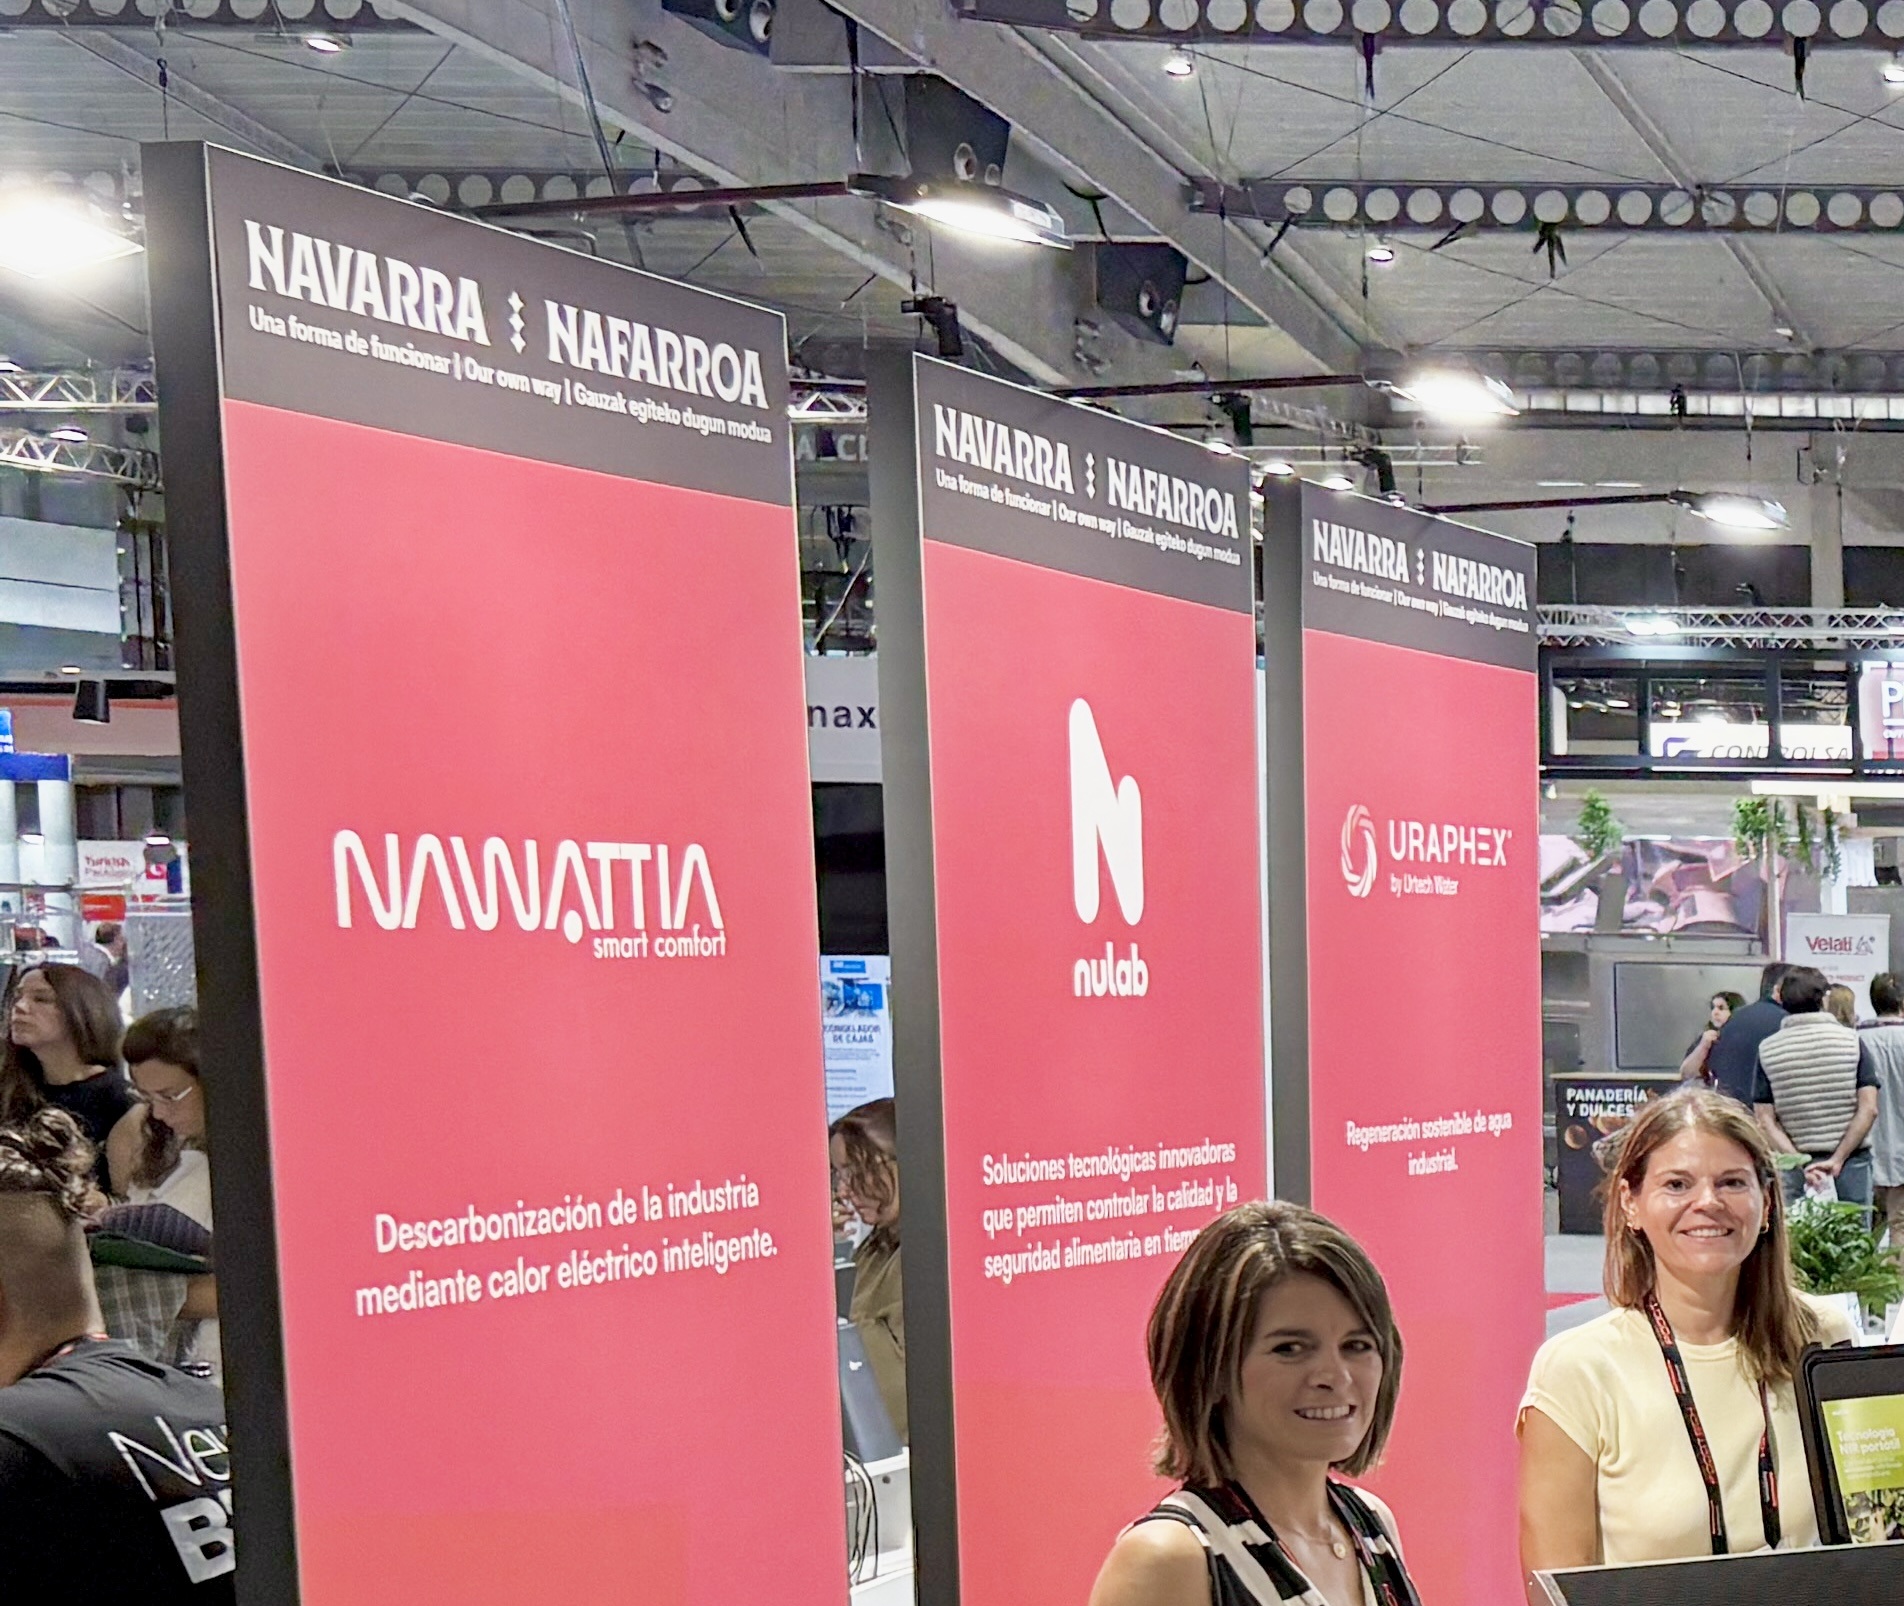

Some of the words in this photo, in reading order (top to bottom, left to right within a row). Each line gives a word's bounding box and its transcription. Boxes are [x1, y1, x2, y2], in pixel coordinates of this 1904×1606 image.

[244, 219, 491, 346] NAVARRA
[545, 300, 769, 410] NAFARROA
[249, 304, 287, 338] Una
[288, 314, 343, 351] forma
[344, 330, 369, 355] de
[369, 333, 450, 375] funcionar
[465, 357, 494, 384] Our
[496, 372, 530, 393] own
[532, 378, 562, 404] way
[574, 382, 628, 415] Gauzak
[629, 396, 681, 425] egiteko
[682, 407, 725, 437] dugun
[727, 418, 772, 443] modua
[933, 403, 1075, 495] NAVARRA
[1107, 456, 1239, 539] NAFARROA
[1004, 487, 1052, 517] funcionar
[1312, 519, 1410, 583] NAVARRA
[1432, 551, 1529, 611] NAFARROA
[593, 931, 648, 958] smart
[654, 923, 726, 957] comfort
[1074, 941, 1148, 997] nulab
[1473, 1109, 1487, 1133] de
[1566, 1085, 1648, 1102] PANADERÍA
[1566, 1103, 1576, 1117] Y
[1580, 1103, 1635, 1117] DULCES
[982, 1153, 1065, 1186] Soluciones
[1069, 1144, 1156, 1182] tecnológicas
[1159, 1137, 1236, 1170] innovadoras
[375, 1194, 602, 1254] Descarbonización
[607, 1188, 638, 1226] de
[642, 1185, 663, 1221] la
[668, 1174, 759, 1218] industria
[983, 1208, 1013, 1239] que
[1017, 1195, 1083, 1237] permiten
[1086, 1187, 1150, 1220] controlar
[1152, 1185, 1165, 1213] la
[1166, 1178, 1213, 1211] calidad
[1215, 1185, 1225, 1212] y
[1226, 1175, 1238, 1202] la
[356, 1268, 482, 1317] mediante
[488, 1256, 550, 1299] calor
[557, 1243, 658, 1289] eléctrico
[663, 1227, 778, 1275] inteligente.
[984, 1239, 1061, 1284] seguridad
[1064, 1230, 1141, 1268] alimentaria
[1144, 1235, 1162, 1256] en
